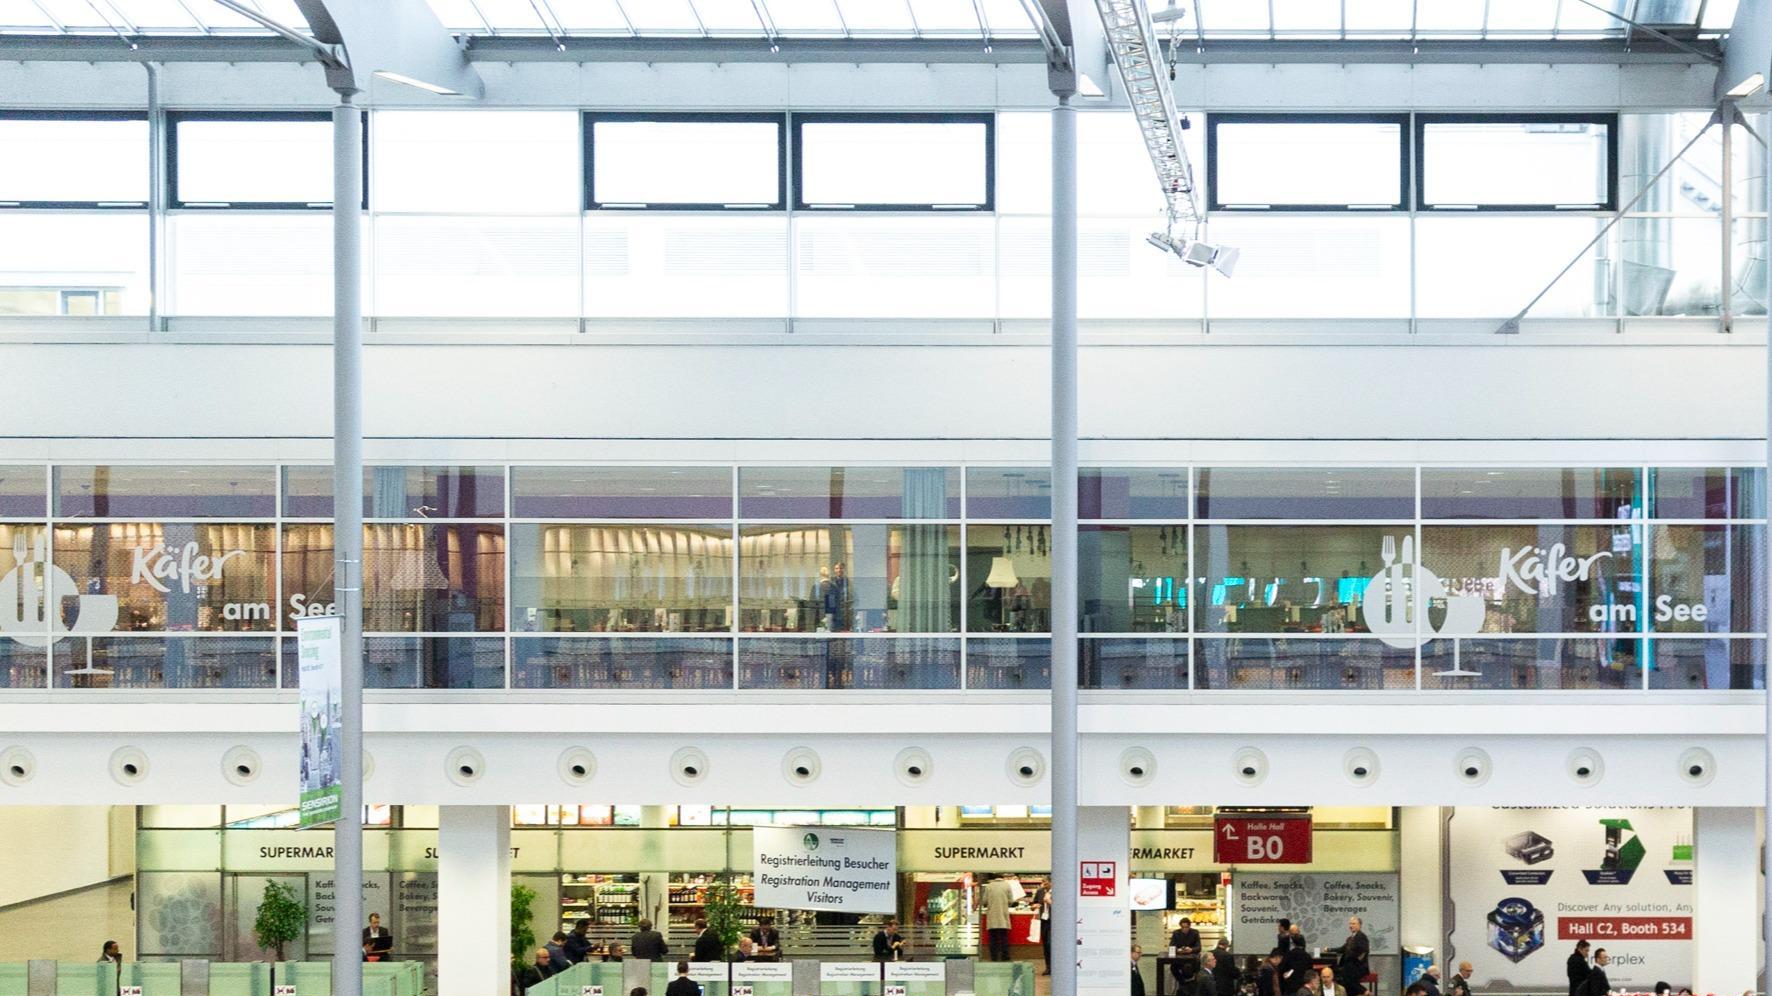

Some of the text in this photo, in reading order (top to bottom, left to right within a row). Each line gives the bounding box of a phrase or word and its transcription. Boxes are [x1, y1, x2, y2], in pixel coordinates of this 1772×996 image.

[131, 541, 245, 593] Käfer
[1500, 542, 1613, 596] Käfer
[224, 601, 270, 620] am
[1589, 595, 1708, 622] am See
[1247, 822, 1285, 831] Halle Hall
[260, 847, 334, 858] SUPERMAR
[934, 846, 1025, 859] SUPERMARKT
[1129, 847, 1195, 859] RMARKET
[761, 854, 889, 871] Registrierleitung Besucher
[761, 874, 890, 892] Registration Management
[807, 891, 844, 904] Visitors
[399, 904, 438, 913] Beverage
[1557, 902, 1599, 912] Discover
[1603, 903, 1622, 914] Any
[1626, 902, 1672, 913] solution,
[1569, 923, 1685, 936] Hall C2, Booth 534
